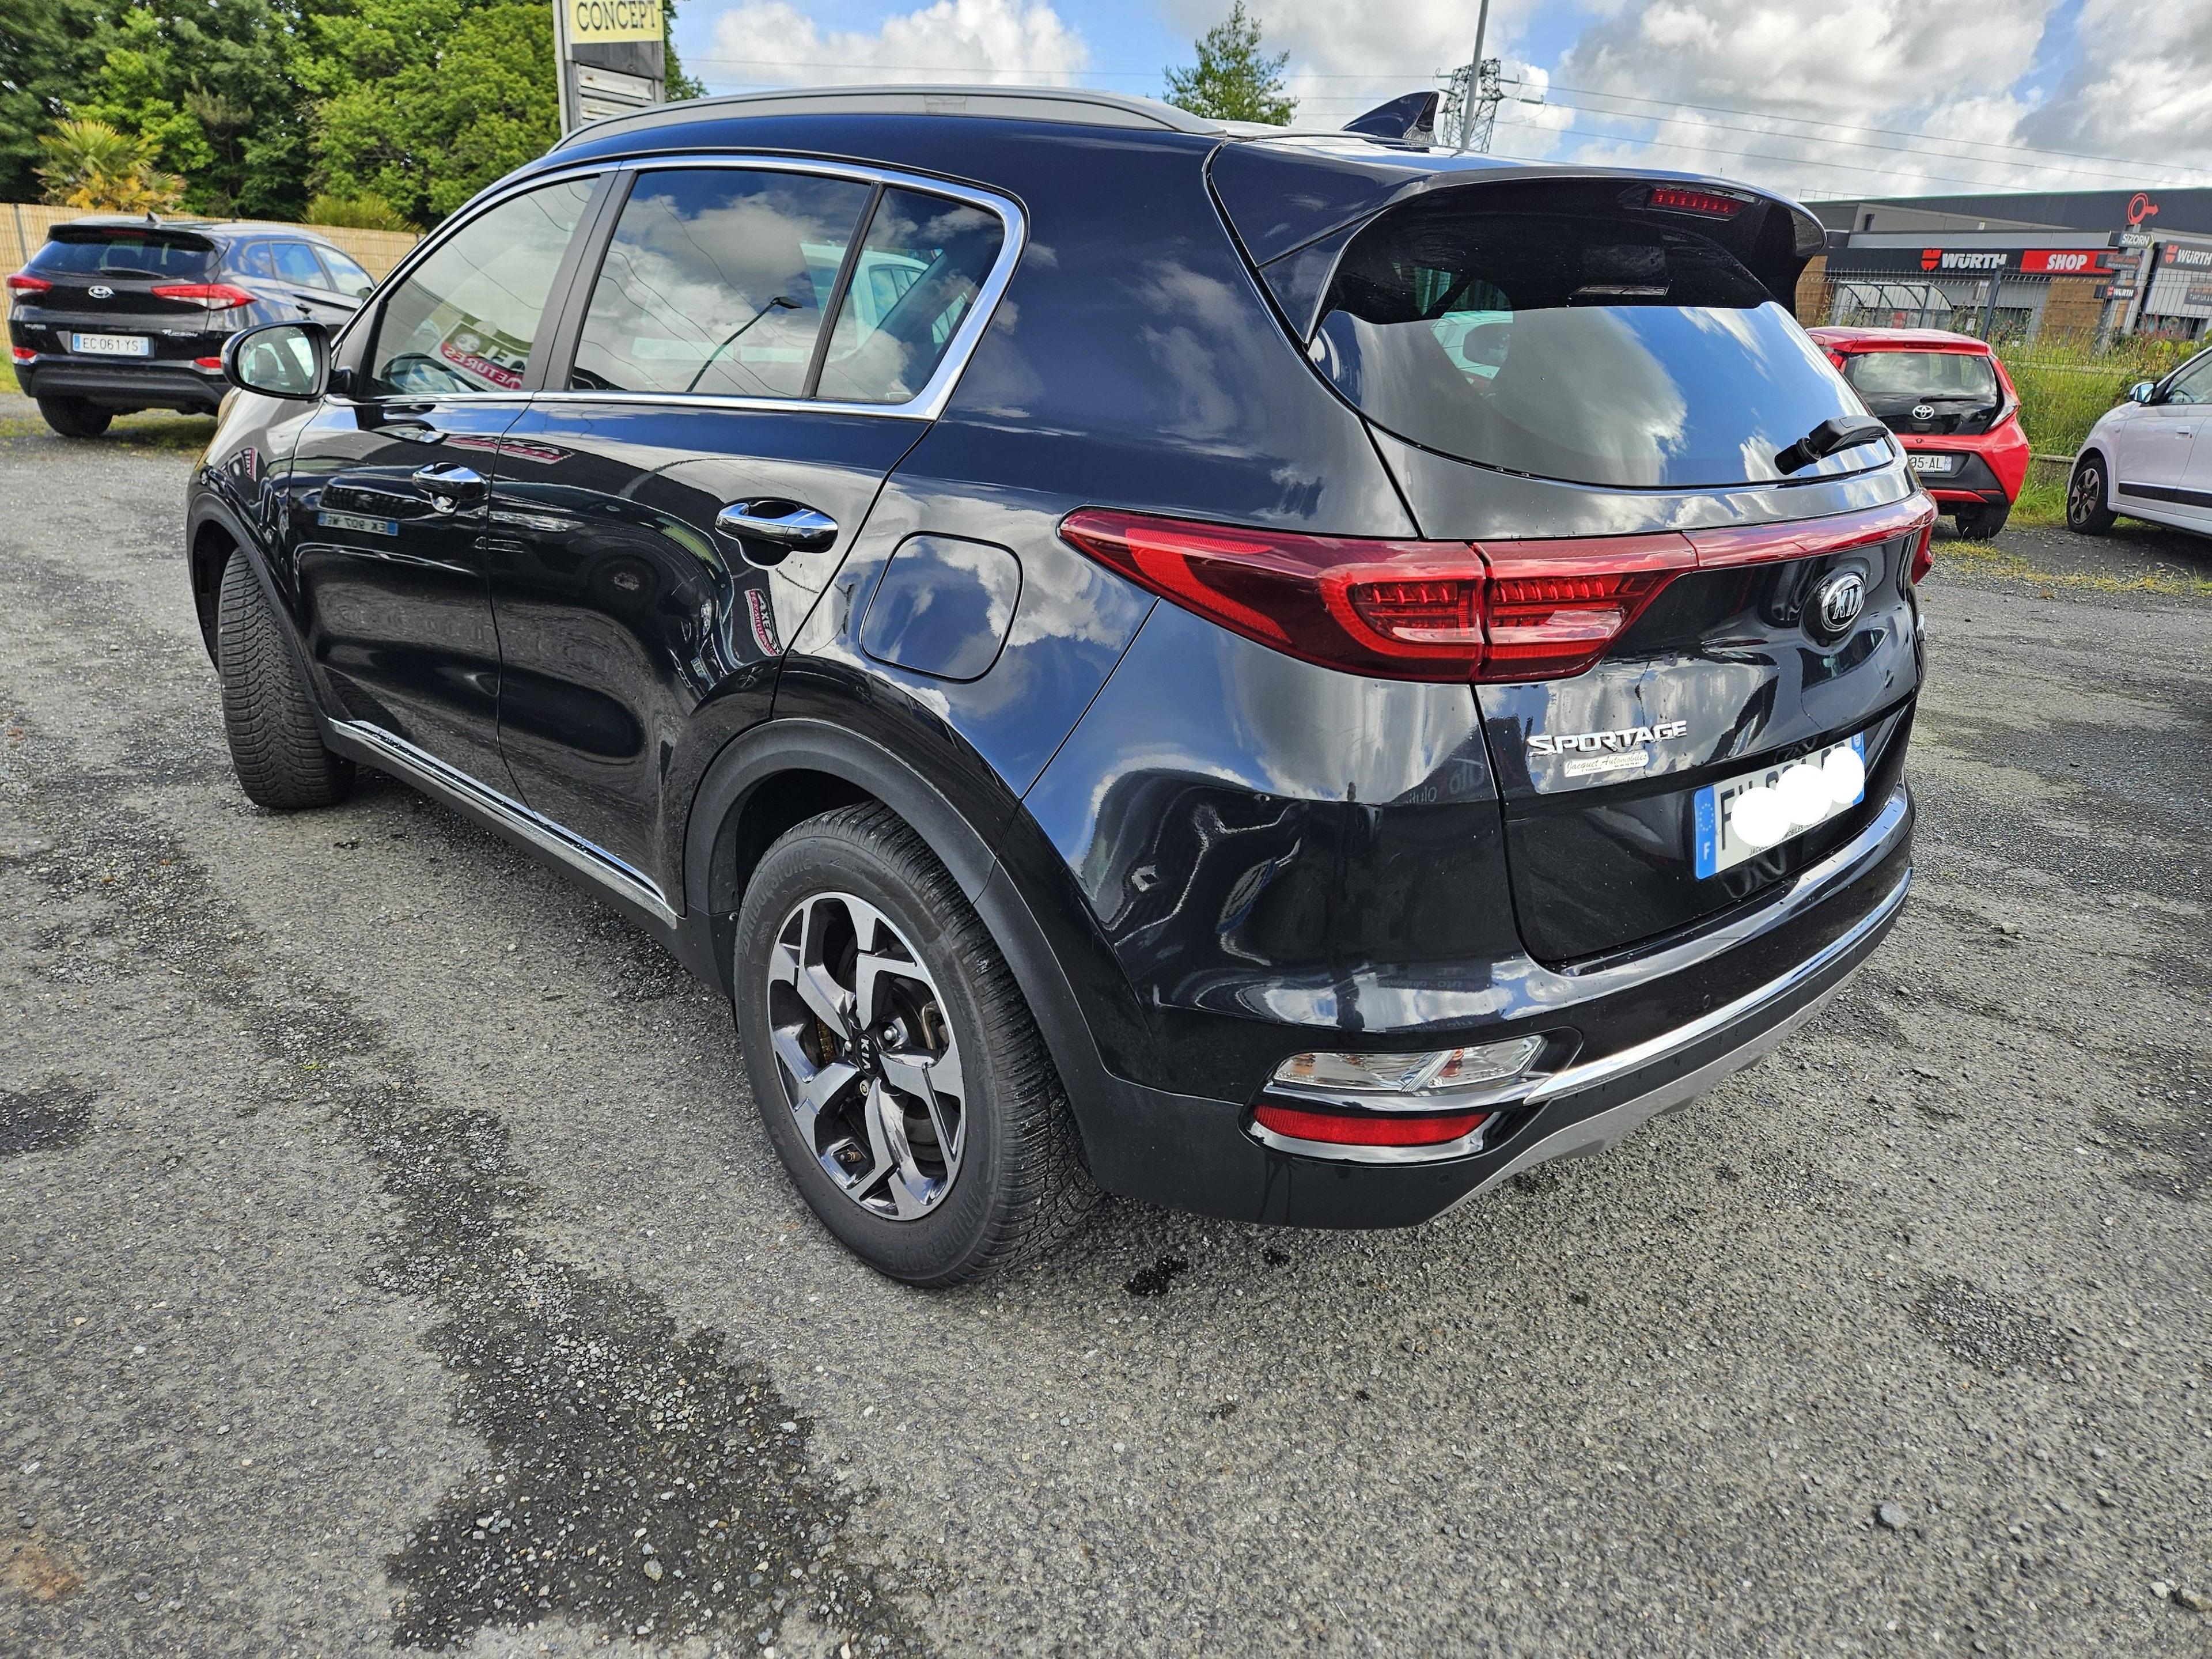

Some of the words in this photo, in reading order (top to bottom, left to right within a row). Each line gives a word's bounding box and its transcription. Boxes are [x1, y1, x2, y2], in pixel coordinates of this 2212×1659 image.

[577, 1, 654, 31] CONCEPT
[1942, 253, 2007, 269] WÜRTH
[2047, 254, 2087, 270] SHOP
[1832, 586, 1862, 619] KIA
[1527, 721, 1687, 757] SPORTAGE
[861, 1039, 870, 1069] KIA
